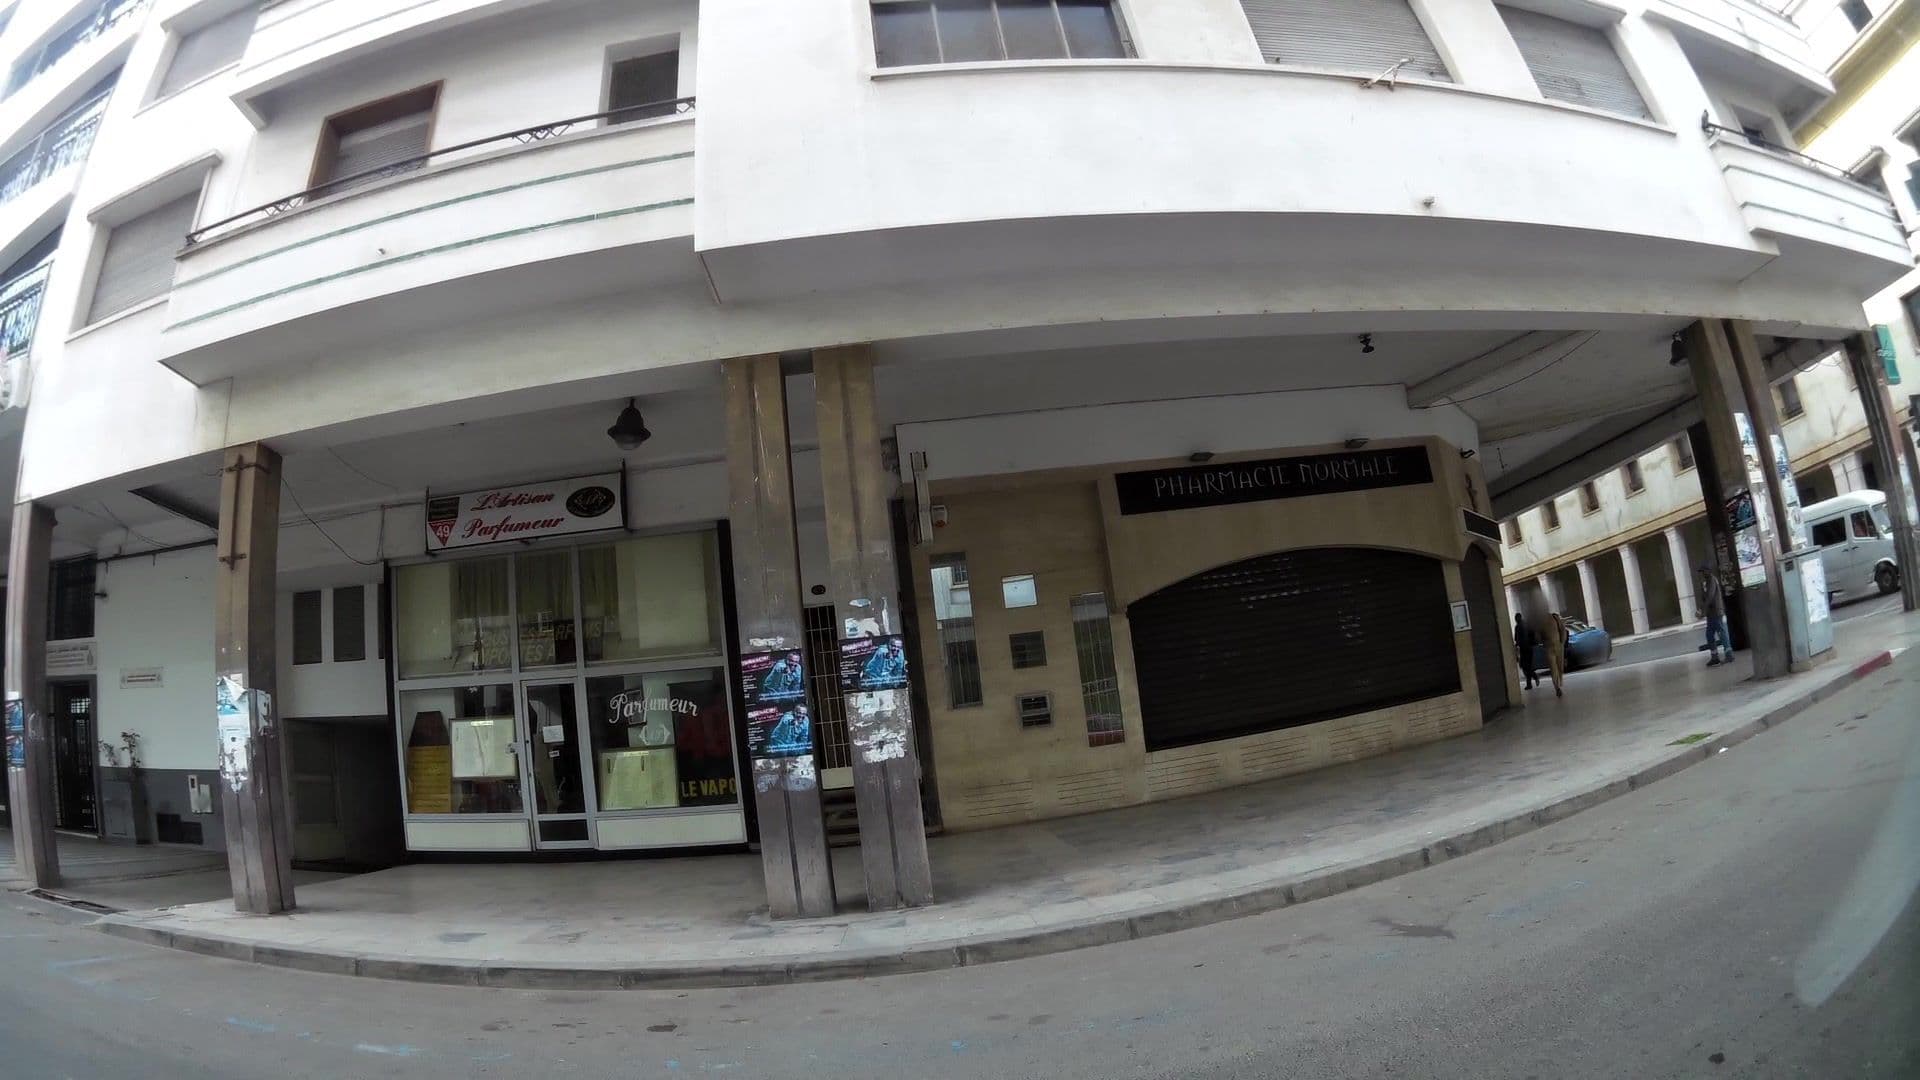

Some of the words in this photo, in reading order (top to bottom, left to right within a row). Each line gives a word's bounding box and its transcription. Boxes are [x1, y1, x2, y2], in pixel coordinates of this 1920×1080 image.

[1153, 463, 1291, 498] PHARMACIE
[1299, 455, 1400, 485] NORMALE
[470, 491, 555, 512] L'Artisan
[436, 525, 451, 539] 49
[462, 515, 565, 541] Parfumeur
[608, 688, 698, 723] Parfumeur
[681, 780, 697, 797] LE
